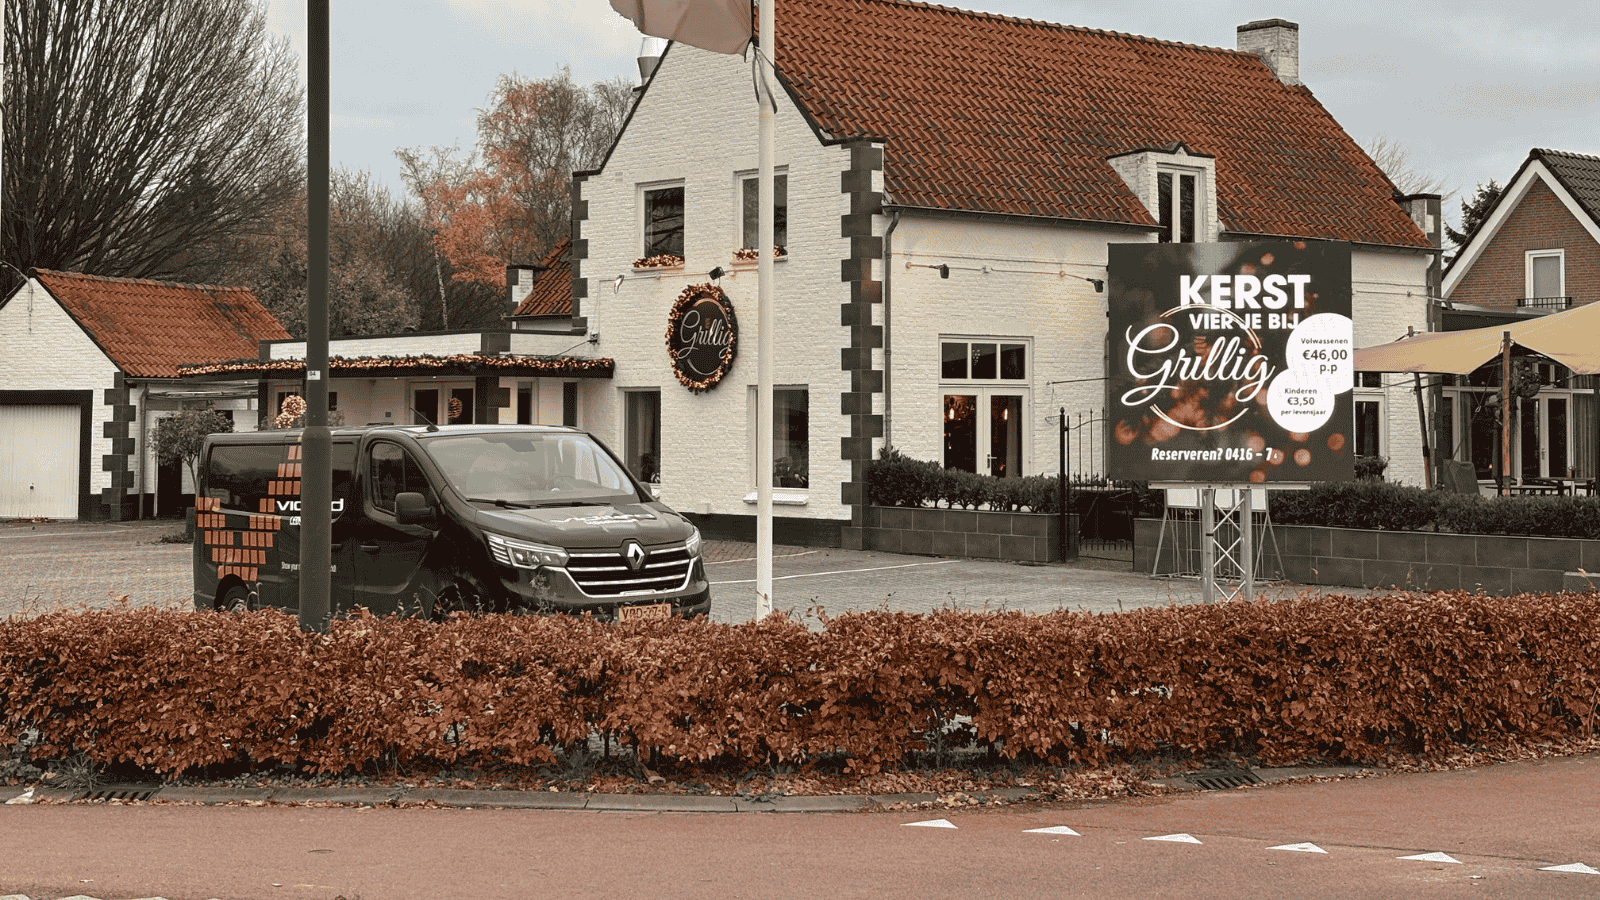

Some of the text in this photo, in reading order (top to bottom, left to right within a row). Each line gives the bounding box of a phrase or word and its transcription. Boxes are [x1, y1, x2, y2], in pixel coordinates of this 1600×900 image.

[1180, 274, 1311, 310] KERST
[1189, 313, 1299, 330] VIER JE BIJ
[1302, 349, 1348, 362] €46,00
[1121, 323, 1276, 406] Grillig
[1319, 364, 1338, 375] p.p
[1287, 397, 1315, 406] €3,50
[1151, 447, 1223, 461] Reserveren?
[1225, 447, 1253, 461] 0416
